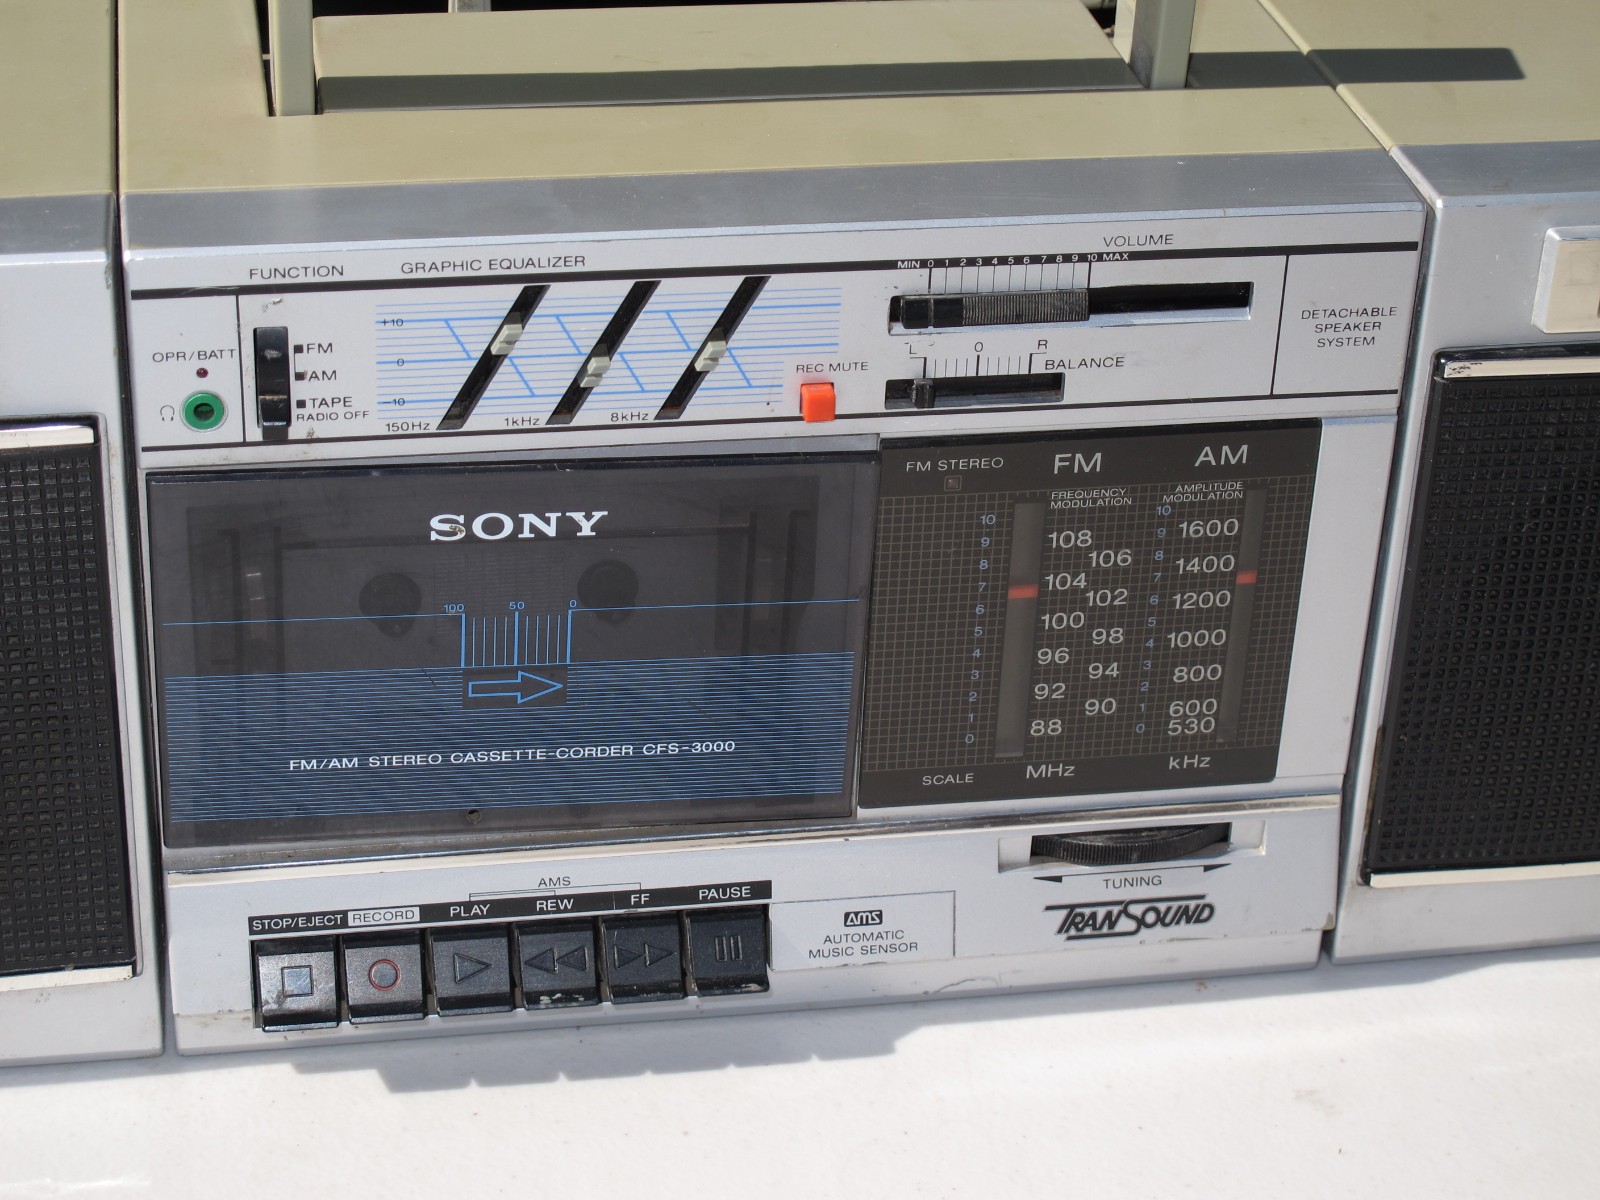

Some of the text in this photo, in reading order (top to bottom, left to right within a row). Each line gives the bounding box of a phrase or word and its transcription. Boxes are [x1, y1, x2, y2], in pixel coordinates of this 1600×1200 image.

[1103, 233, 1174, 248] VOLUME
[400, 255, 586, 275] GRAPHIC EQUALIZER
[897, 260, 920, 269] MIN
[927, 259, 934, 268] 0
[959, 258, 967, 266] 2
[975, 258, 983, 266] 3
[991, 257, 998, 265] 4
[1007, 256, 1015, 265] 5
[1023, 256, 1030, 264] 6
[1041, 255, 1048, 264] 7
[1055, 254, 1063, 263] 8
[1071, 254, 1079, 262] 9
[1086, 253, 1098, 262] 10
[1102, 252, 1129, 261] MAX
[249, 265, 344, 280] FUNCTION
[1301, 306, 1398, 320] DETACHABLE
[1314, 321, 1382, 334] SPEAKER
[306, 342, 334, 355] FM
[909, 344, 918, 355] L
[1037, 339, 1048, 350] R
[1316, 336, 1376, 348] SYSTEM
[152, 348, 236, 363] OPR/BATT
[396, 358, 405, 367] 0
[795, 361, 869, 374] REC MUTE
[1044, 356, 1125, 371] BALANCE
[307, 370, 338, 381] AM
[310, 396, 353, 409] TAPE
[296, 409, 370, 422] RADIO OFF
[1194, 444, 1249, 467] AM
[905, 457, 1004, 472] FM STEREO
[1053, 452, 1102, 474] FM
[1051, 487, 1127, 500] FREQUENCY
[1174, 481, 1244, 493] AMPLITUDE
[1050, 497, 1132, 510] MODULATION
[1162, 490, 1244, 503] MODULATION
[1156, 505, 1172, 516] 10
[429, 510, 608, 541] SONY
[980, 514, 996, 525] 10
[1157, 527, 1166, 538] 9
[1178, 518, 1239, 538] 1600
[980, 537, 990, 547] 9
[1048, 529, 1092, 549] 108
[1088, 549, 1132, 568] 106
[1154, 550, 1164, 561] 8
[979, 559, 989, 570] 8
[1175, 554, 1235, 575] 1400
[1044, 572, 1087, 591] 104
[1153, 572, 1162, 583] 7
[978, 582, 987, 592] 7
[1085, 588, 1128, 607] 102
[1150, 594, 1159, 605] 6
[1172, 590, 1232, 610] 1200
[443, 599, 577, 612] 100 50 0
[975, 604, 985, 615] 6
[1040, 611, 1085, 630] 100
[1147, 616, 1157, 627] 5
[1091, 627, 1124, 645] 98
[1145, 638, 1154, 648] 4
[1166, 628, 1227, 648] 1000
[972, 648, 981, 658] 4
[1037, 647, 1070, 665] 96
[1088, 661, 1120, 679] 94
[1142, 660, 1152, 670] 3
[970, 670, 980, 680] 3
[1172, 664, 1223, 683] 800
[1034, 682, 1066, 700] 92
[1140, 681, 1149, 692] 2
[968, 691, 978, 702] 2
[1084, 697, 1117, 715] 90
[1169, 698, 1218, 717] 600
[1030, 718, 1062, 736] 88
[1135, 723, 1145, 733] 0
[1167, 716, 1216, 736] 530
[964, 734, 975, 744] 0
[289, 740, 736, 771] FM/AM STEREO CASSETTE-CORDER CFS-3000
[1168, 754, 1211, 770] kHz
[1025, 763, 1076, 779] MHz
[922, 772, 974, 786] SCALE
[537, 876, 572, 888] AMS
[1103, 875, 1162, 890] TUNING
[630, 893, 650, 905] FF
[698, 886, 751, 900] PAUSE
[450, 904, 491, 918] PLAY
[535, 898, 575, 912] REW
[252, 914, 344, 931] STOP/EJECT
[352, 909, 416, 923] RECORD
[822, 929, 905, 945] AUTOMATIC
[808, 941, 918, 959] MUSIC SENSOR
